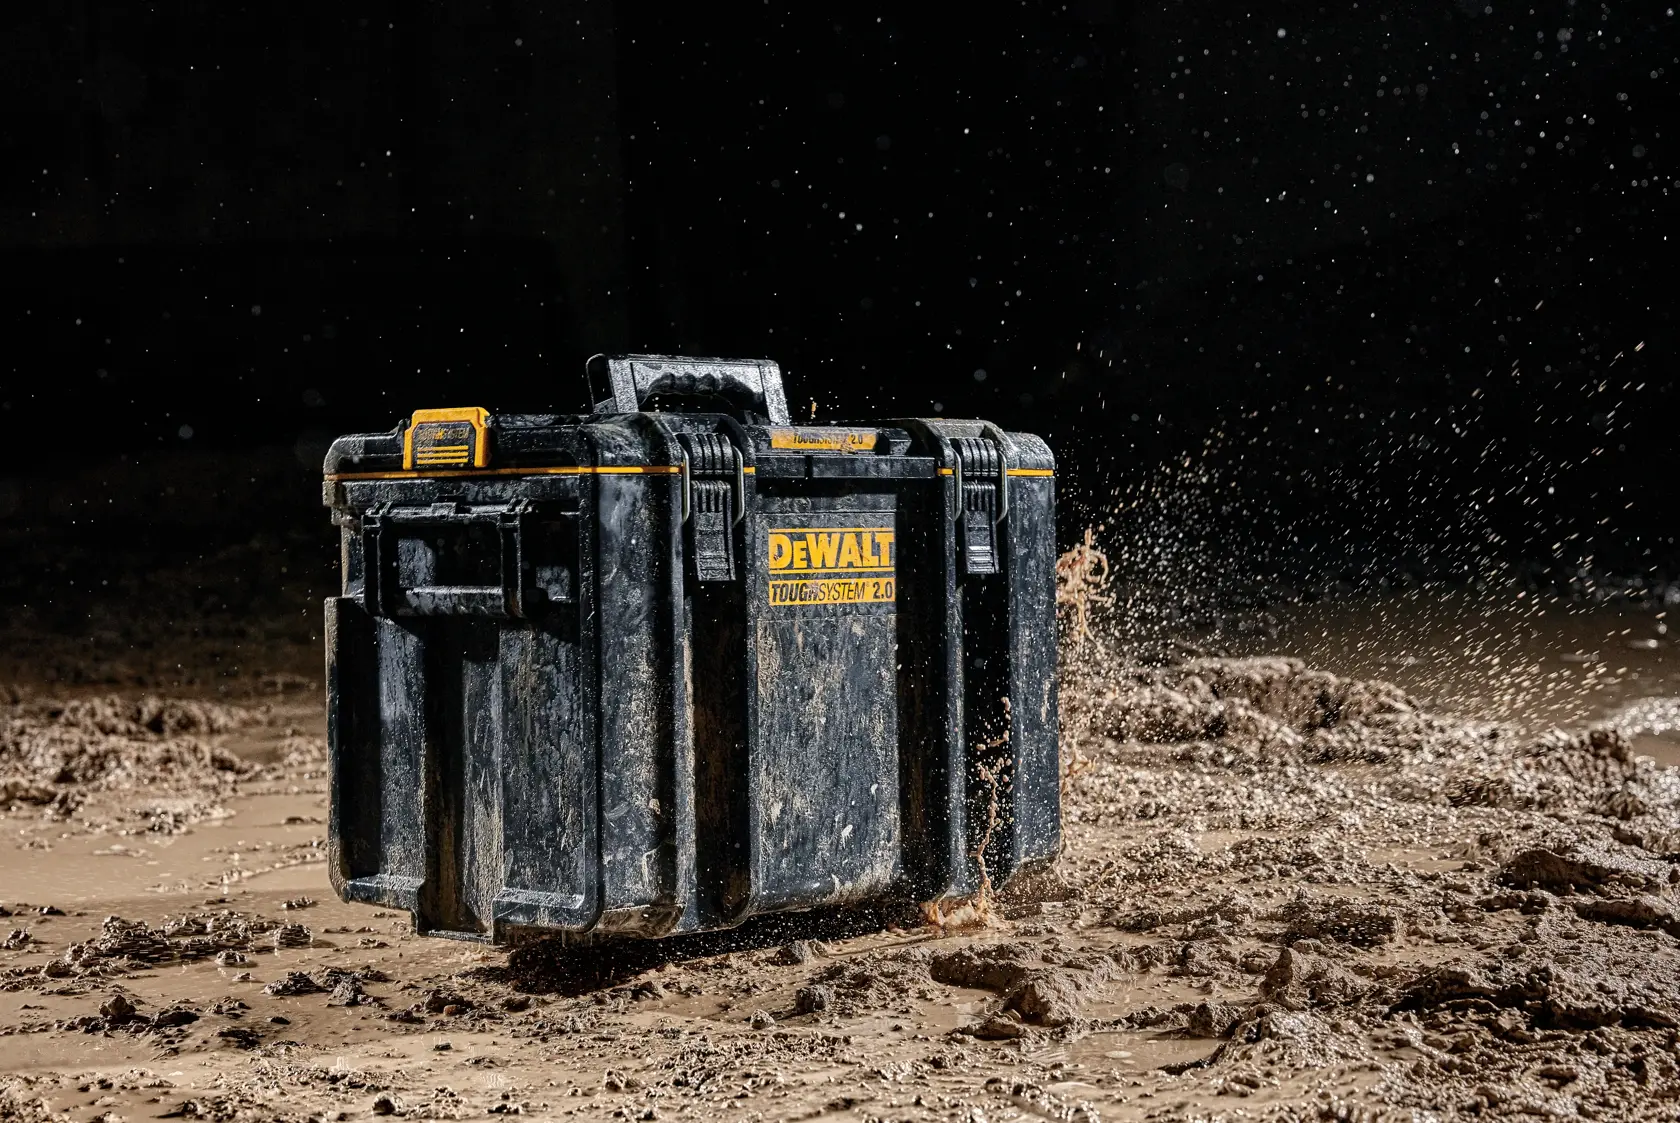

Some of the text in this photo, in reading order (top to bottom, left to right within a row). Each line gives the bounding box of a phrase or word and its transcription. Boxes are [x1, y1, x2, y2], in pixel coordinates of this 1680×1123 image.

[850, 433, 864, 445] 2.0
[771, 581, 893, 602] TOUGHSYSTEM 2.0
